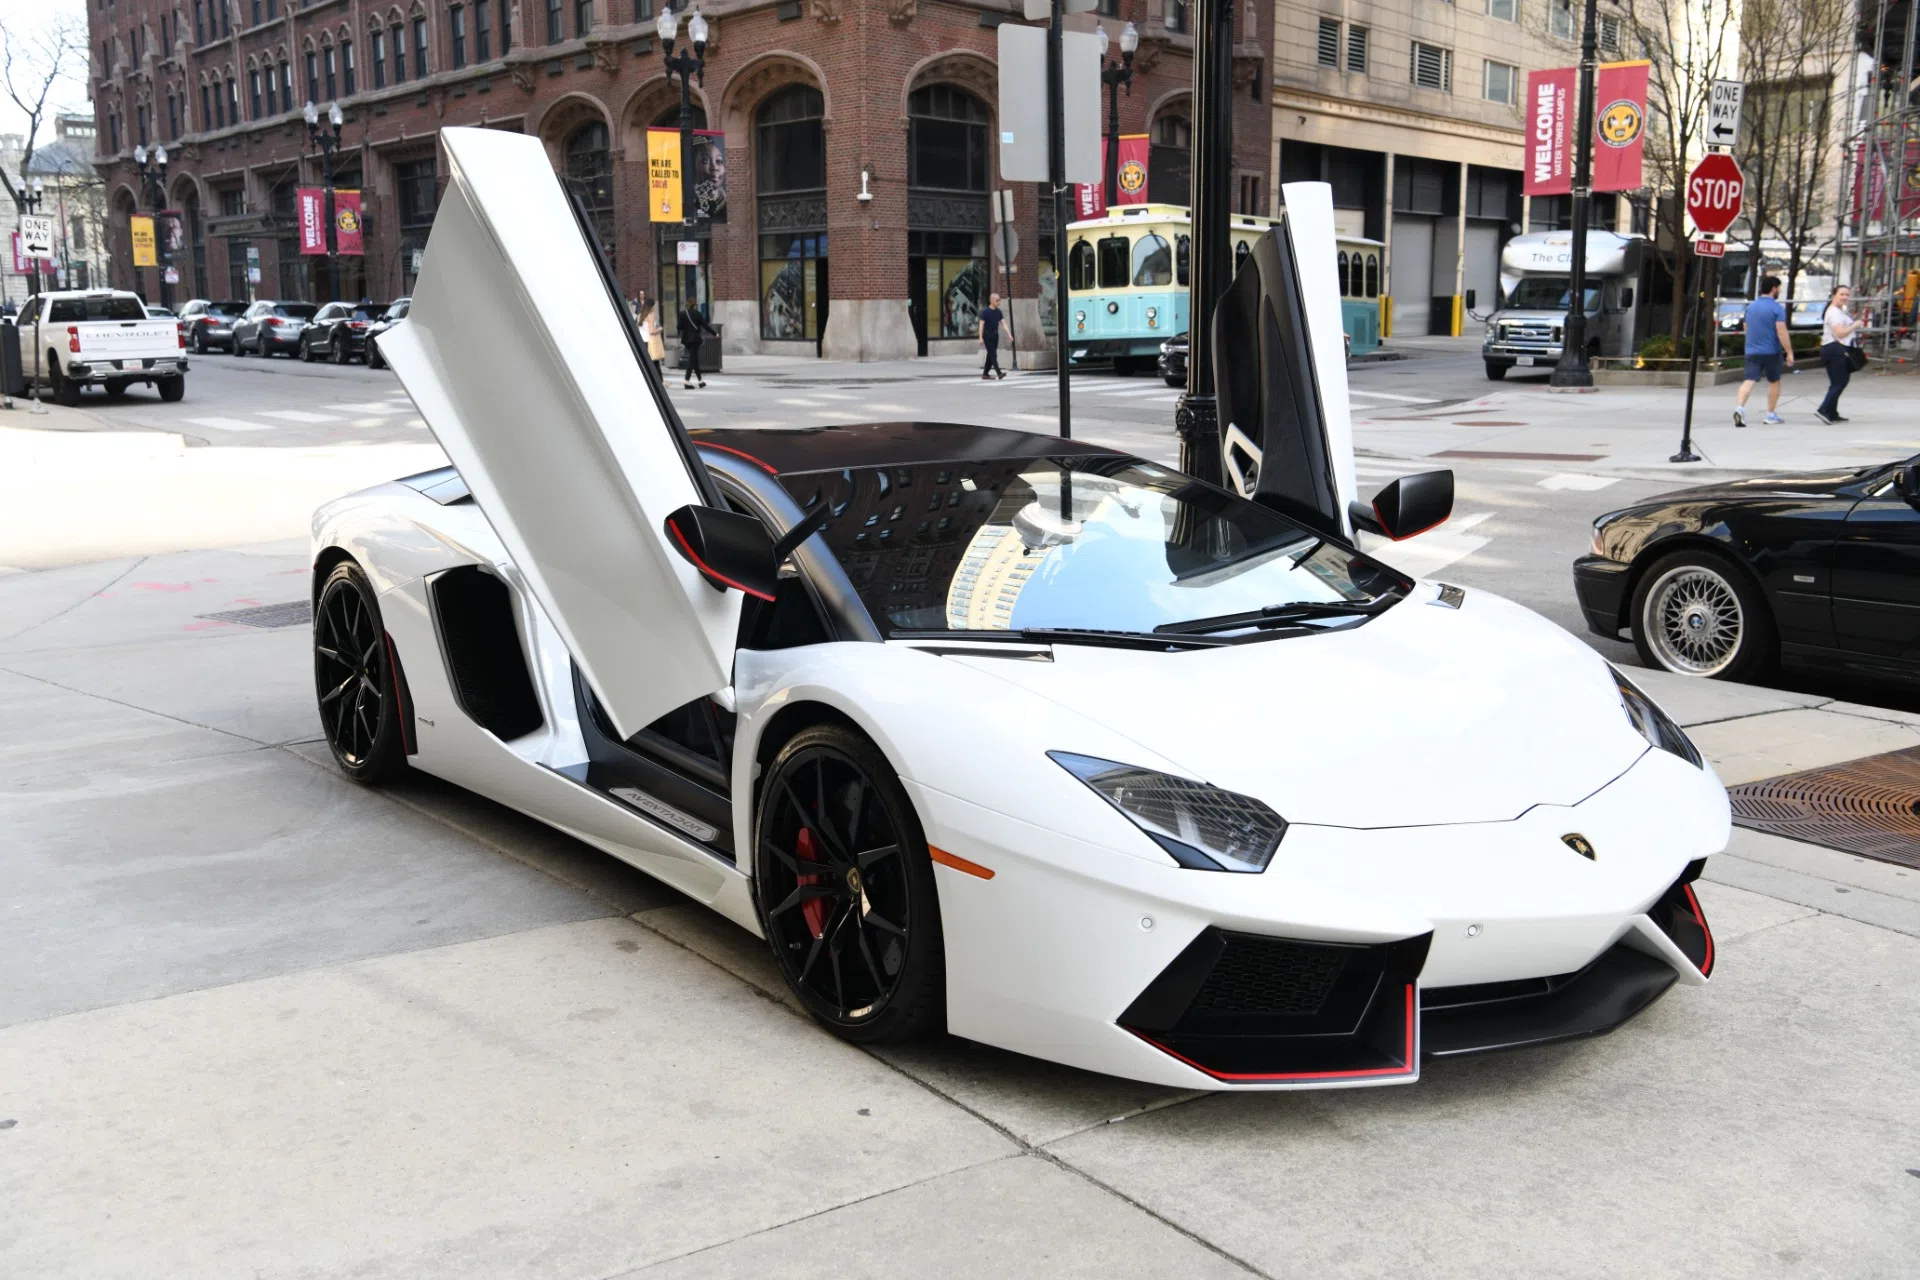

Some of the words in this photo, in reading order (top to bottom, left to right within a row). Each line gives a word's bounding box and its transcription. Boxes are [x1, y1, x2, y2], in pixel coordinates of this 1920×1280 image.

[1715, 85, 1739, 101] ONE
[1556, 88, 1566, 120] CAMPUS
[1713, 103, 1738, 119] WAY
[1534, 83, 1555, 183] WELCOME
[1555, 121, 1564, 149] TOWER
[651, 159, 659, 167] WE
[661, 159, 671, 168] ARE
[1554, 150, 1563, 176] WATER
[651, 169, 671, 178] CALLED
[672, 170, 679, 178] TO
[1081, 183, 1094, 216] WEL
[1690, 177, 1740, 210] STOP
[25, 220, 49, 231] ONE
[303, 196, 315, 248] WELCOME
[24, 231, 50, 241] WAY
[1698, 241, 1709, 253] ALL
[1710, 243, 1722, 254] WAY
[1532, 253, 1553, 262] The
[86, 331, 169, 339] CHEVROLET
